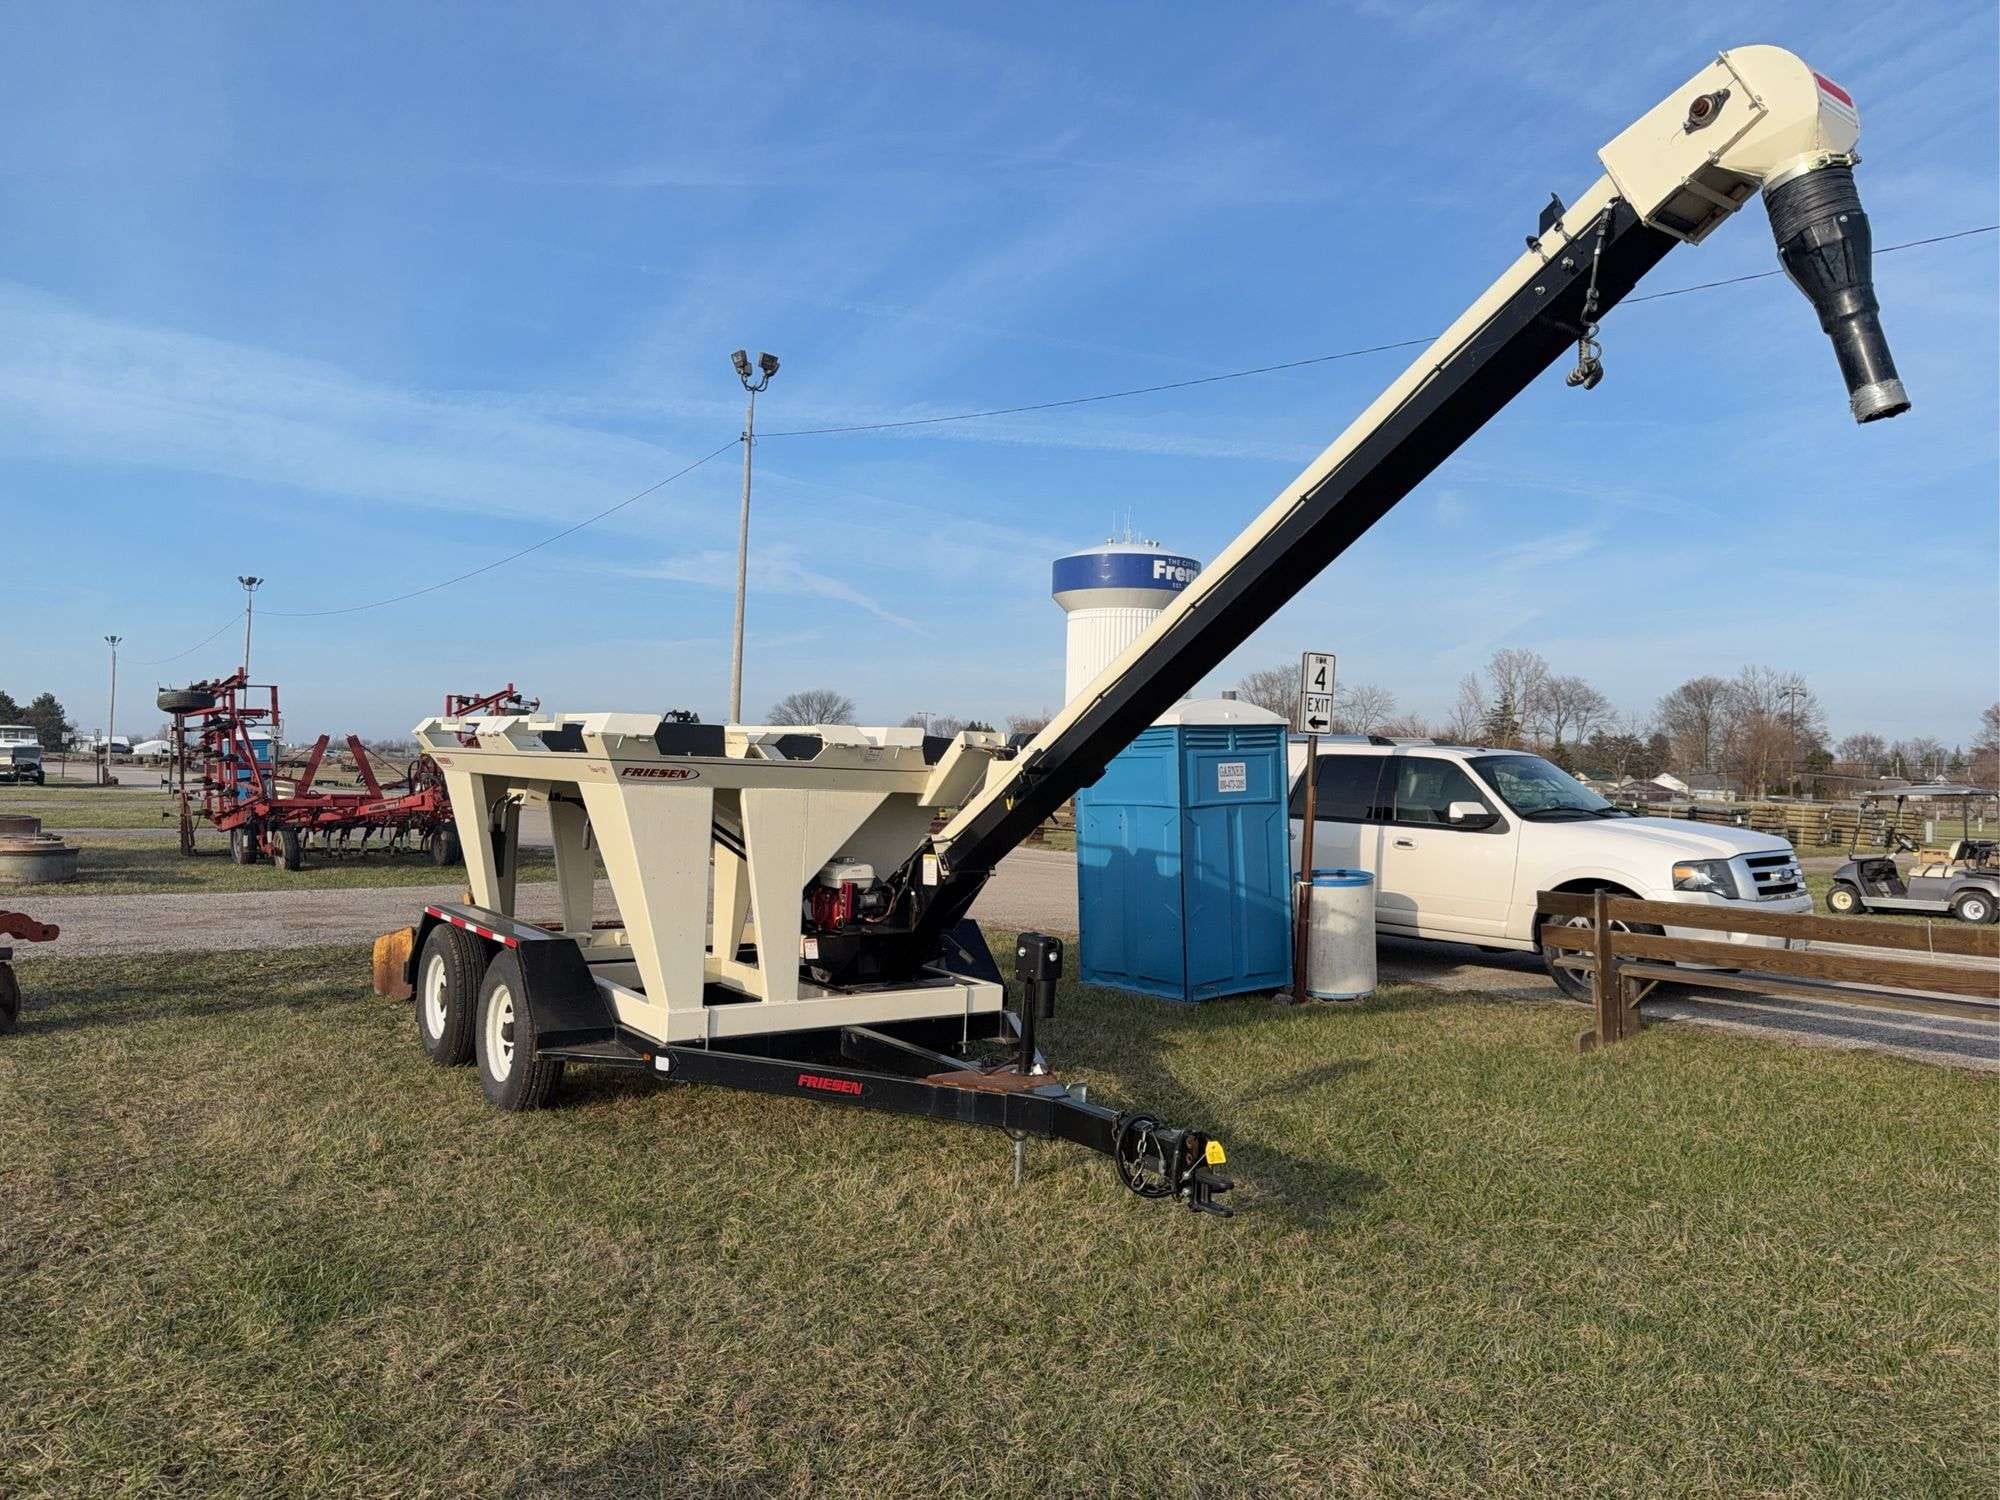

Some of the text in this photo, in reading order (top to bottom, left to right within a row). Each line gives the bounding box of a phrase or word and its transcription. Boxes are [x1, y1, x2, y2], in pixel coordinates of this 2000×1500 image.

[1168, 558, 1180, 566] THE
[1314, 666, 1326, 691] 4
[1307, 697, 1330, 713] EXIT
[621, 767, 691, 779] FRIESEN
[798, 1074, 864, 1095] FRIESEN
